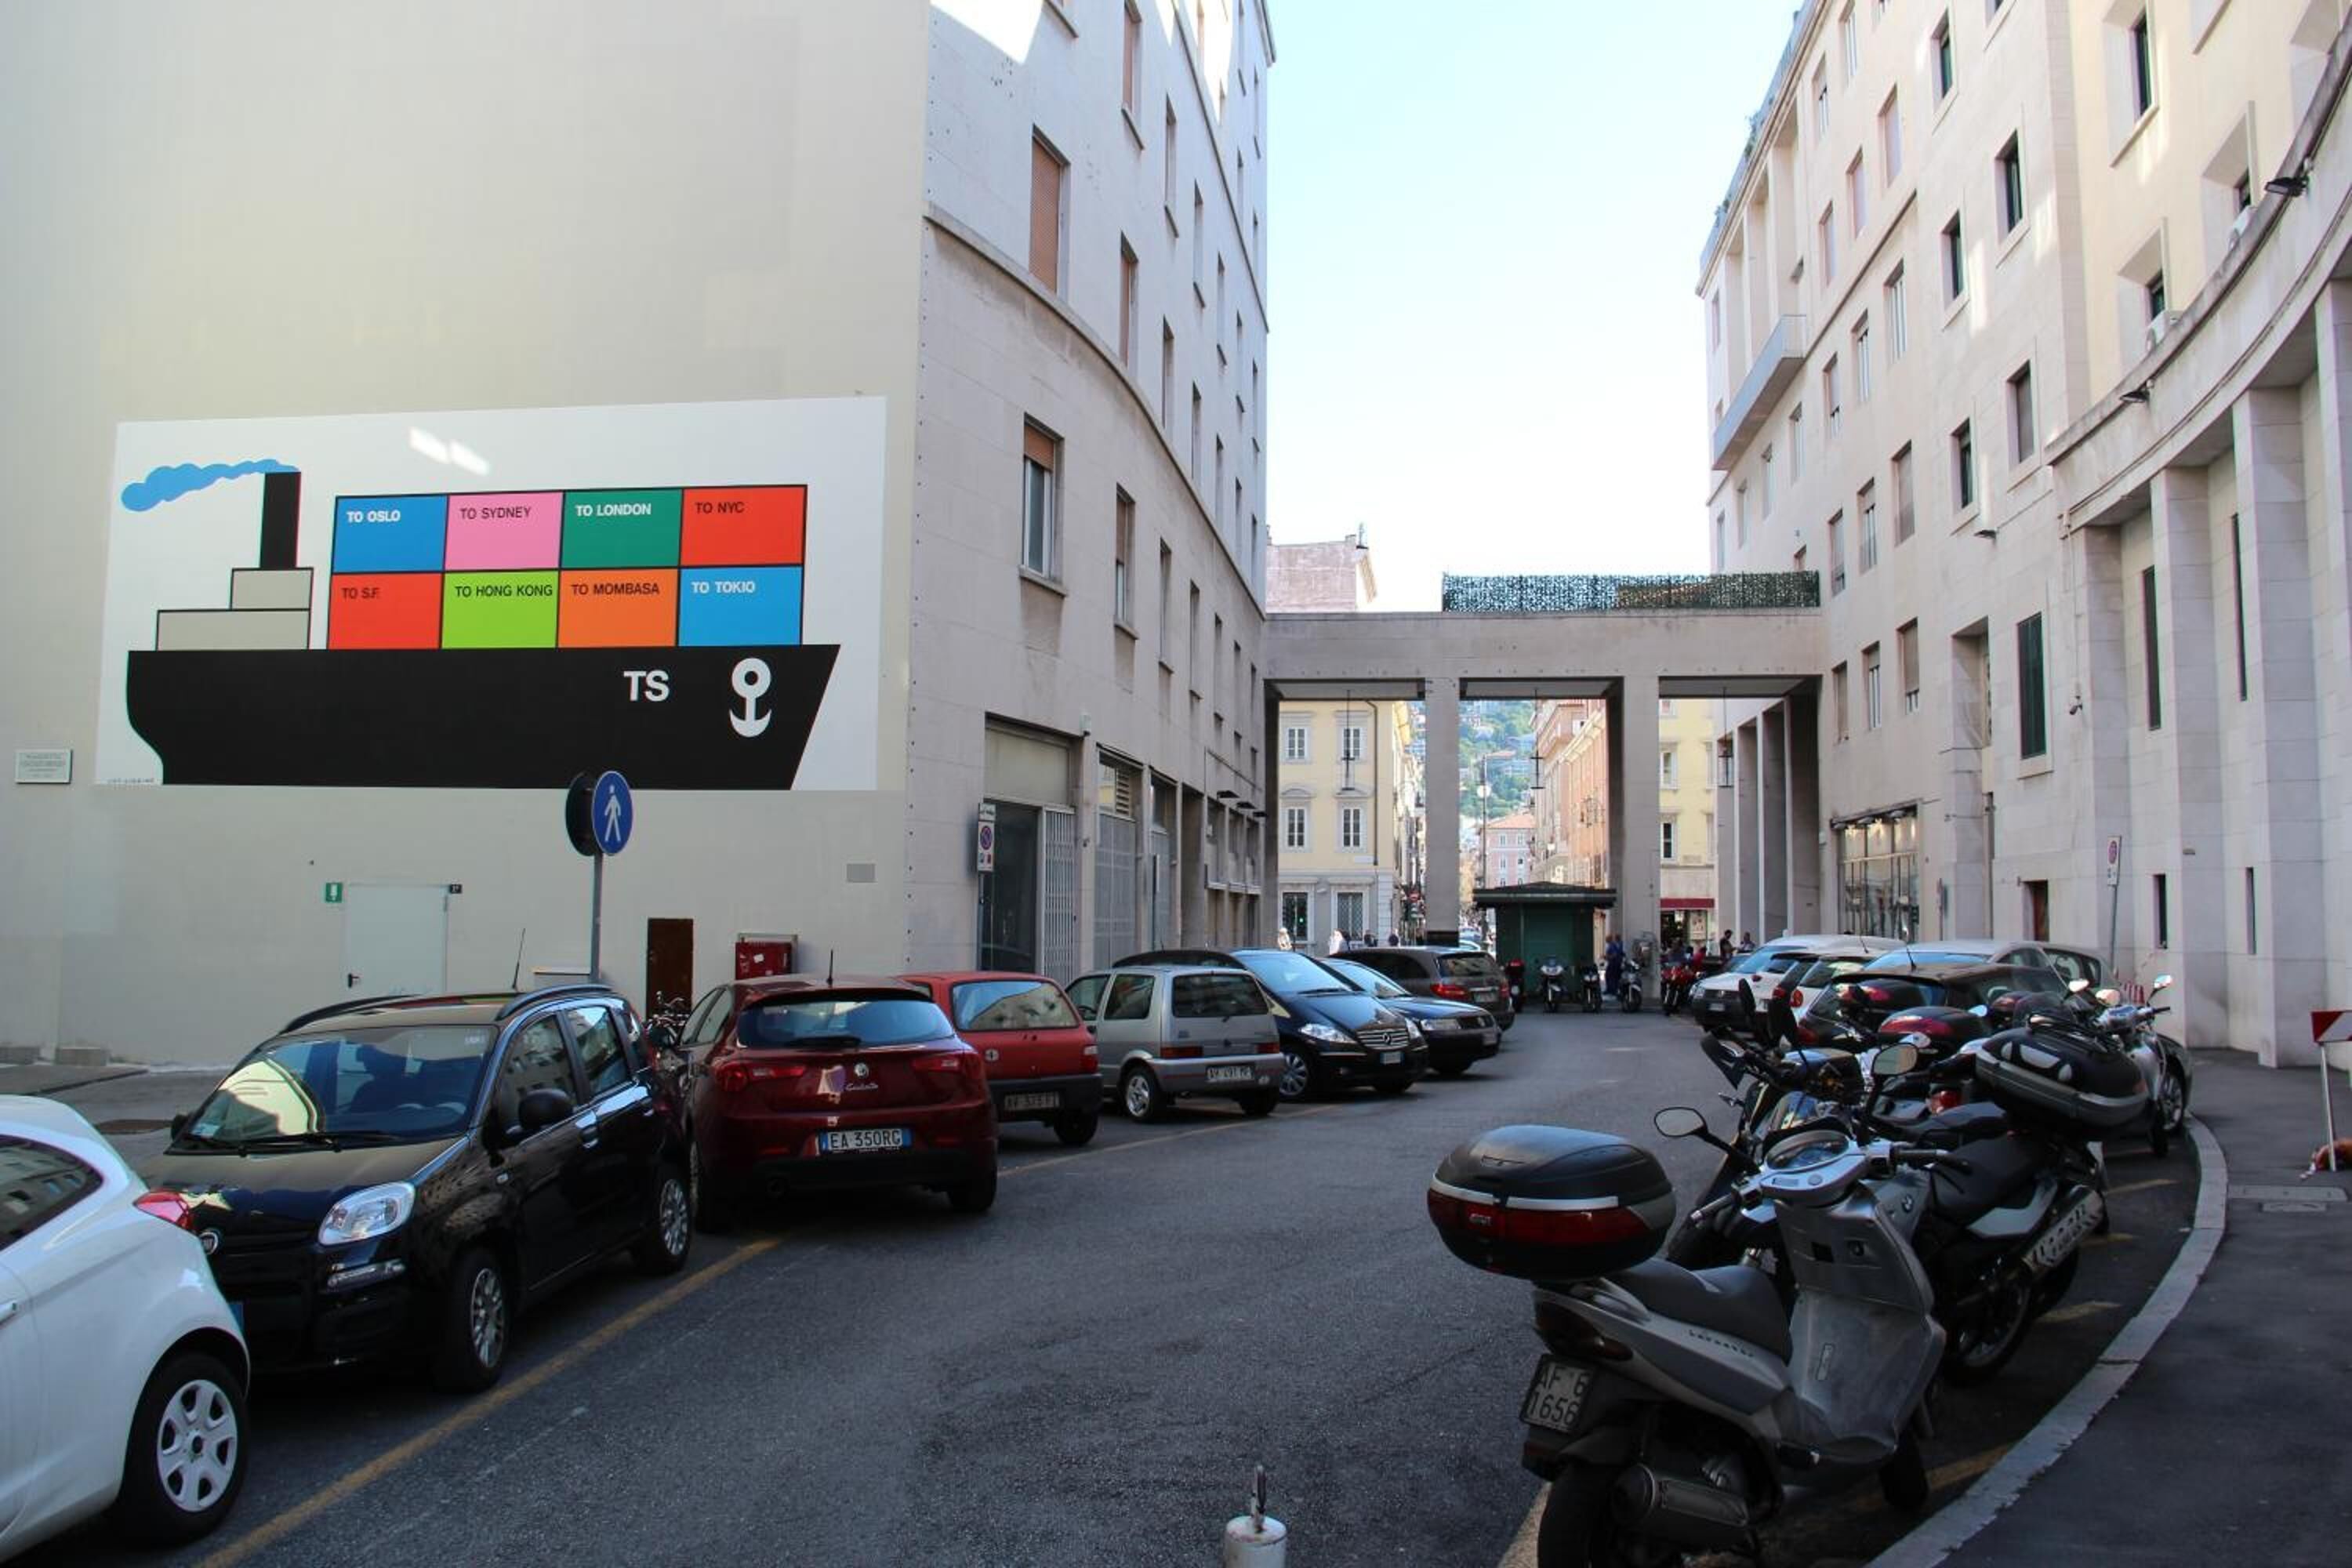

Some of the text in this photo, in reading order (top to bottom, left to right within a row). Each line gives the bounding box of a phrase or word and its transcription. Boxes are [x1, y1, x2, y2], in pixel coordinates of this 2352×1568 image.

[459, 506, 532, 520] TO SYDNEY
[575, 503, 652, 517] TO LONDON
[695, 501, 744, 514] TO NYC
[347, 510, 401, 523] TO OSLO
[341, 587, 358, 600] TO
[455, 583, 553, 597] TO HONG KONG
[572, 582, 660, 596] TO MOMBASA
[691, 580, 755, 594] TO TOKIO
[623, 670, 670, 702] TS
